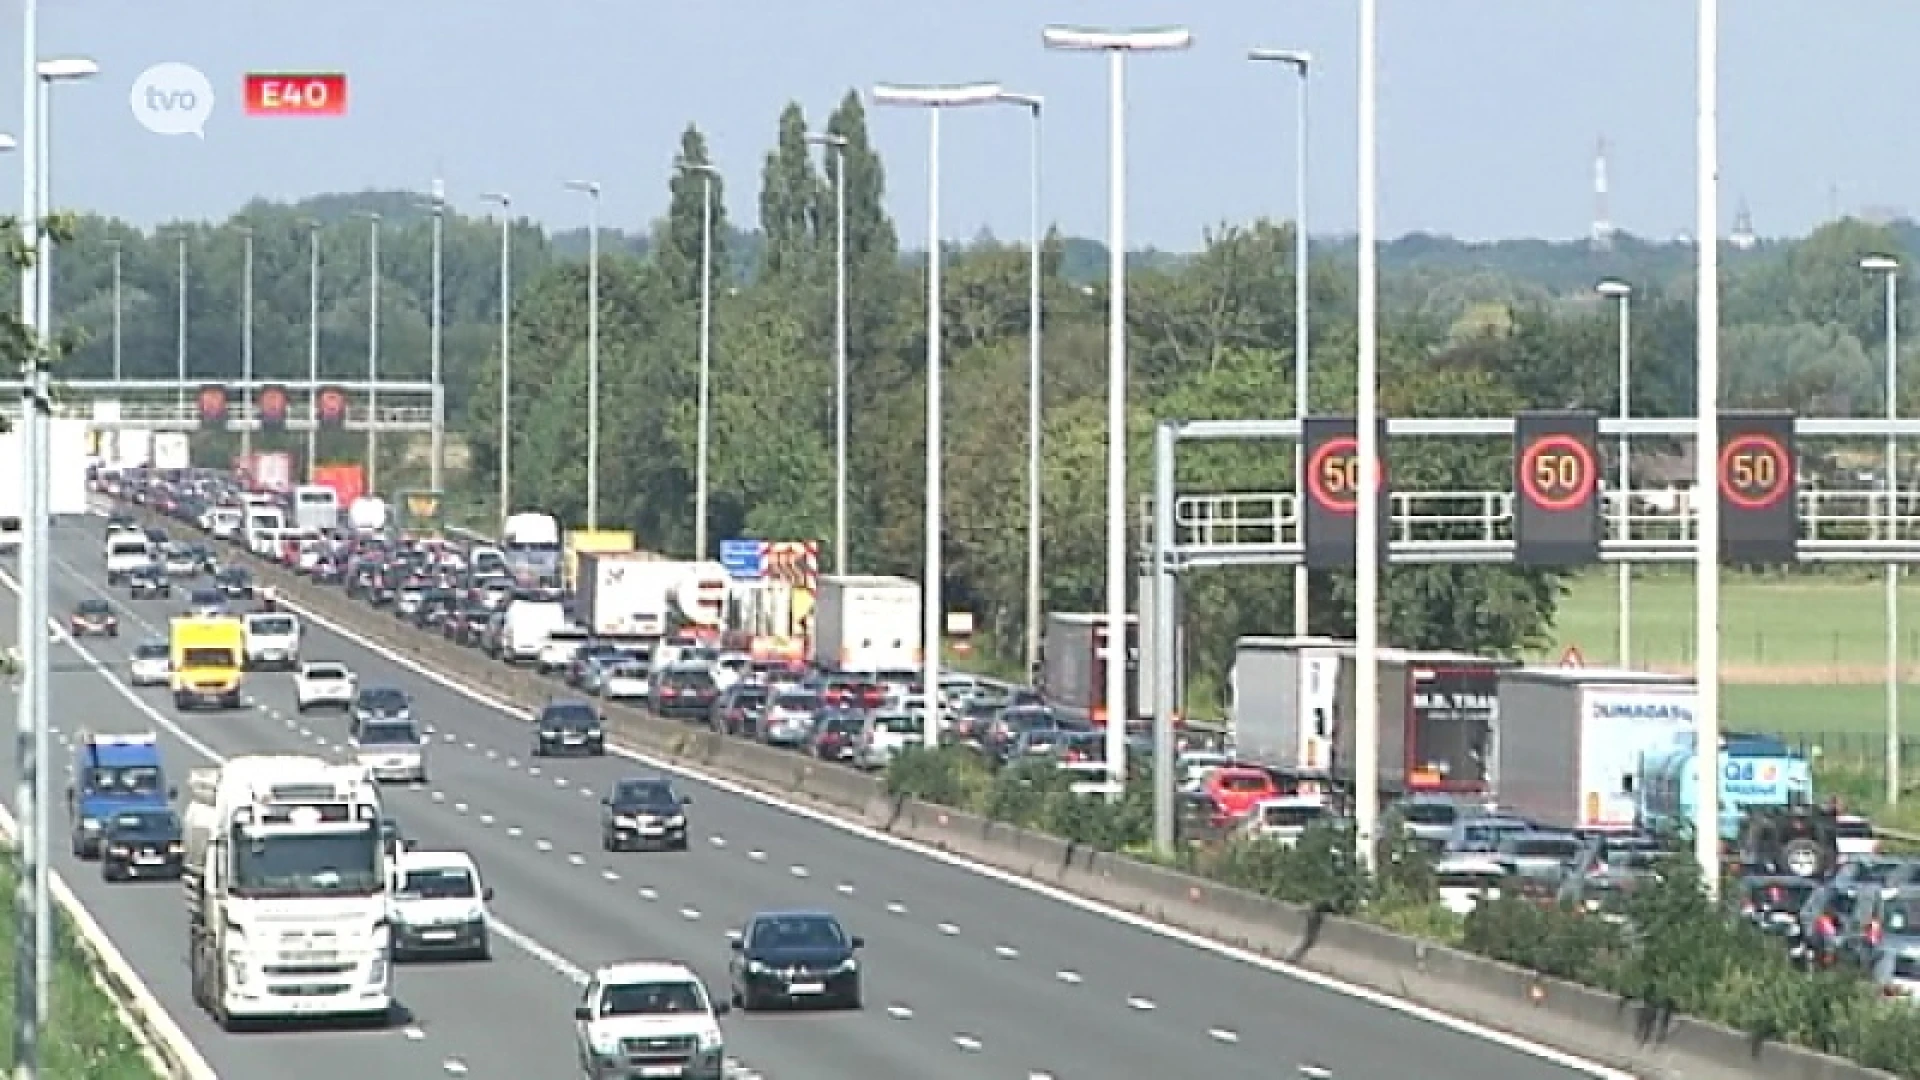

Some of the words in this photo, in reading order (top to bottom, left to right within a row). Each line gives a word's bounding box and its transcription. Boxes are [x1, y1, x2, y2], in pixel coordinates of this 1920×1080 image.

[1324, 455, 1359, 492] 50
[1536, 455, 1578, 491] 50
[1733, 455, 1775, 488] 50
